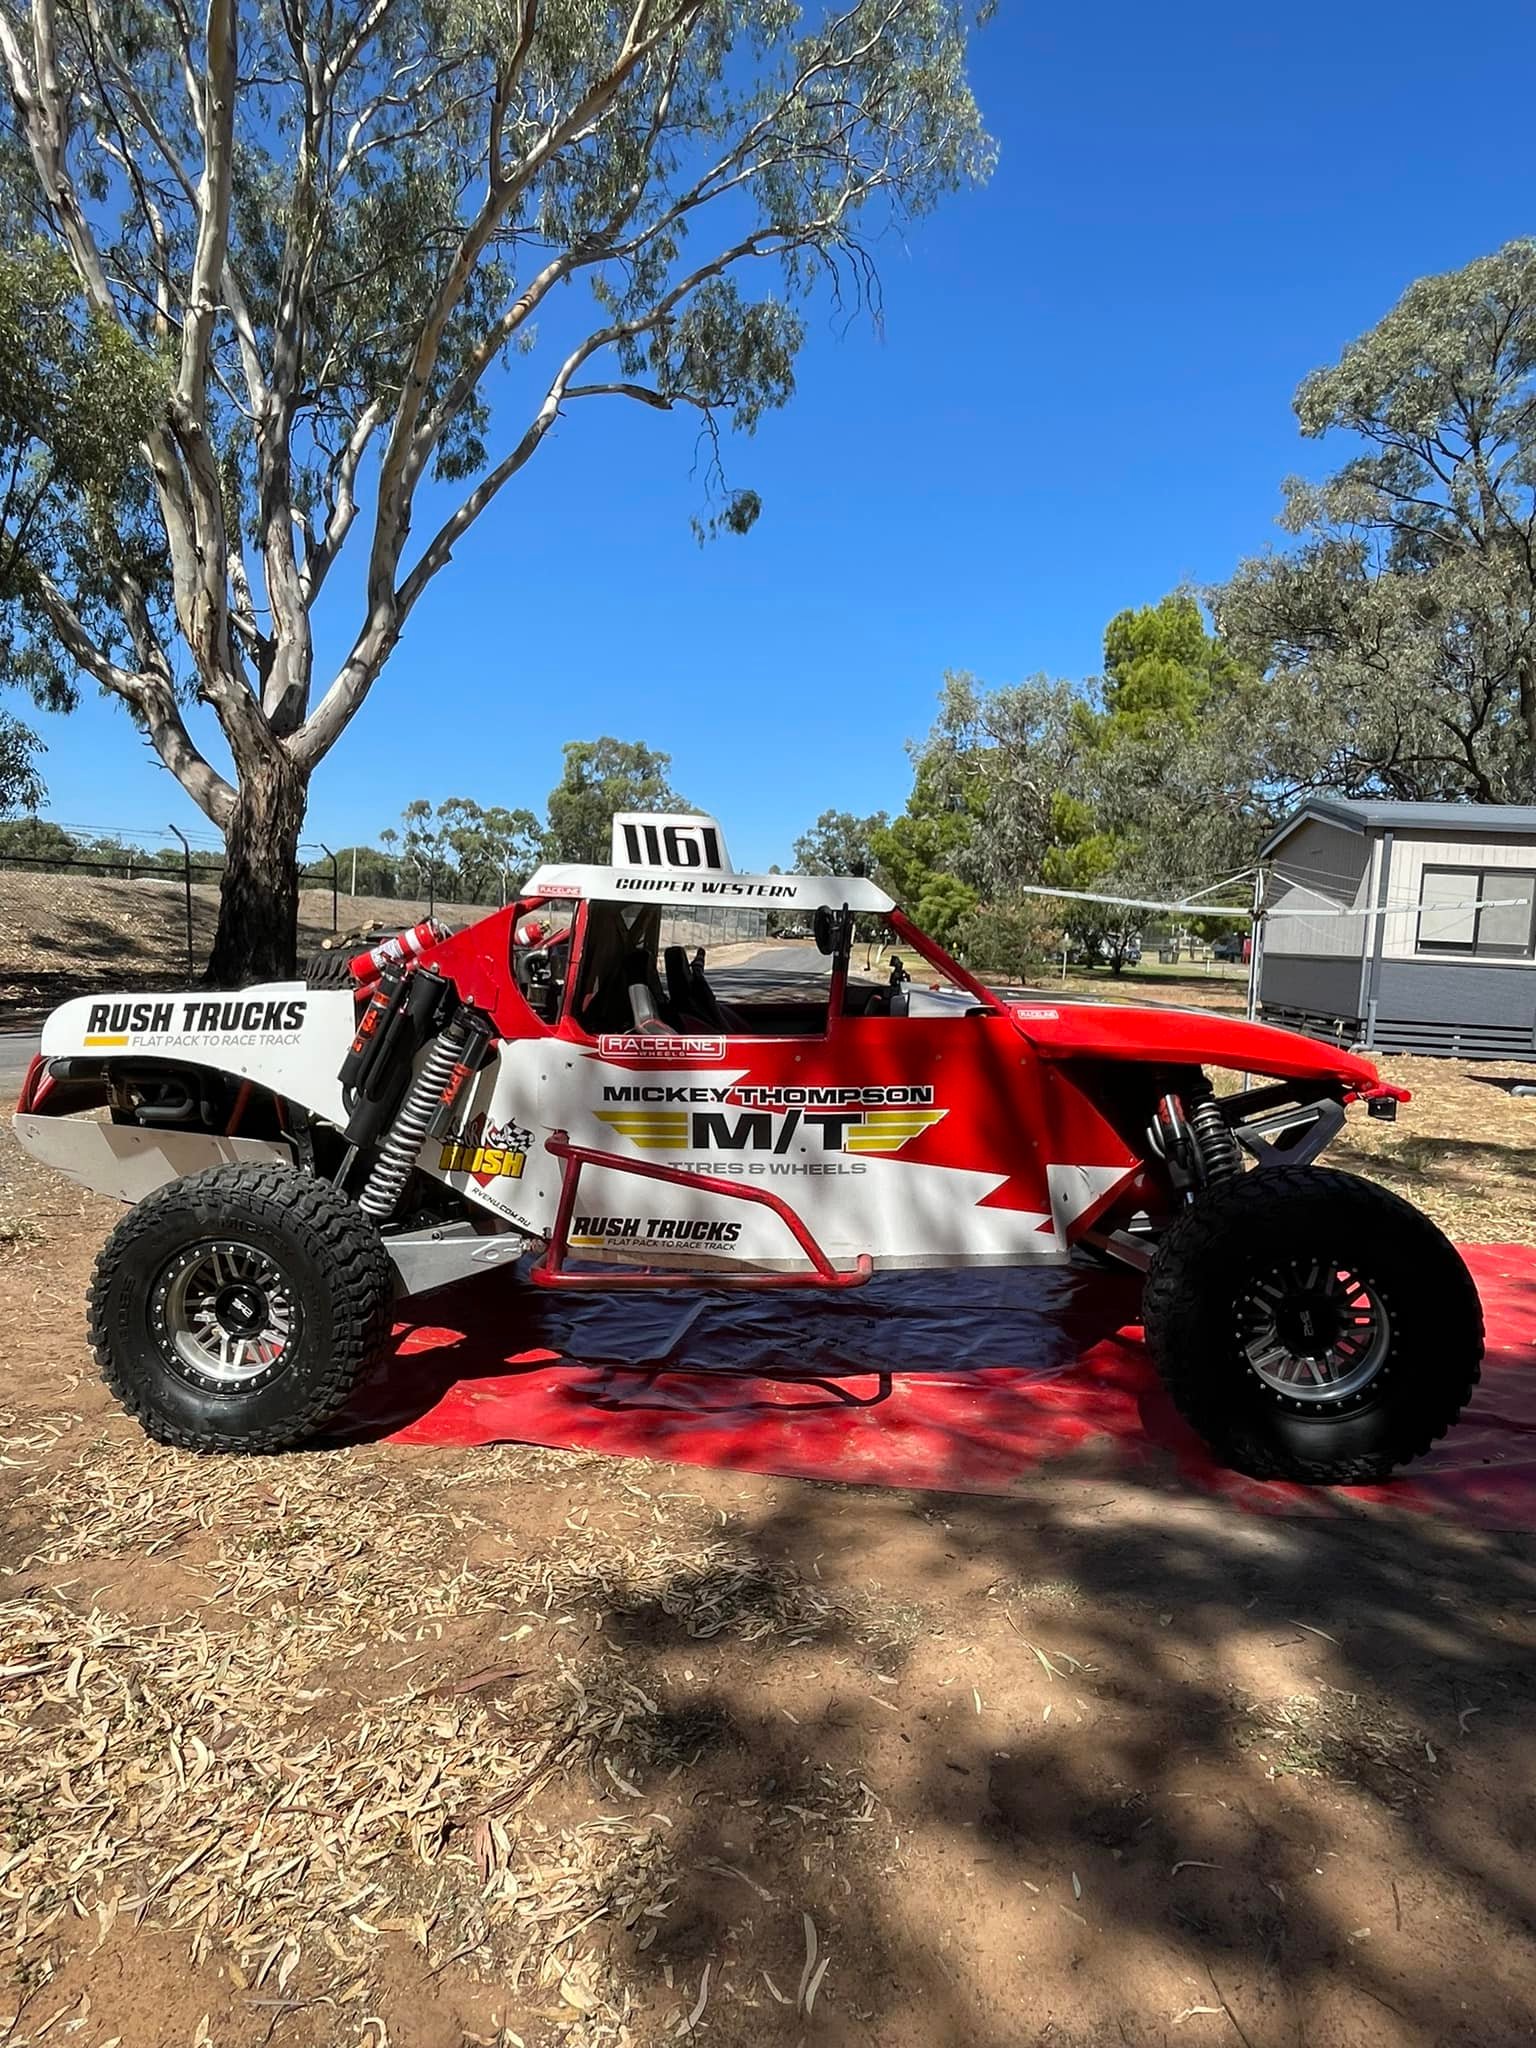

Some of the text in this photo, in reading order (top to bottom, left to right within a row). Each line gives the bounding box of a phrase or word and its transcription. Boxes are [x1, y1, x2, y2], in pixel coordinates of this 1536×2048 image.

[622, 823, 722, 869] 1161
[540, 886, 579, 895] RACELINE
[615, 877, 798, 898] COOPER WESTERN
[86, 1001, 308, 1033] RUSH TRUCKS
[132, 1033, 302, 1047] FLAT PACK TO RACE TRACK
[608, 1037, 715, 1051] RACELINE
[602, 1085, 932, 1105] MICKEY THOMPSON
[692, 1108, 862, 1155] M/T
[439, 1143, 527, 1180] RUSH
[667, 1161, 868, 1176] TIRES & WHEELS
[471, 1186, 532, 1228] RVENU.COM.AU
[572, 1216, 743, 1242] RUSH TRUCKS
[607, 1238, 736, 1251] FLAT PACK TO RACE TRACK
